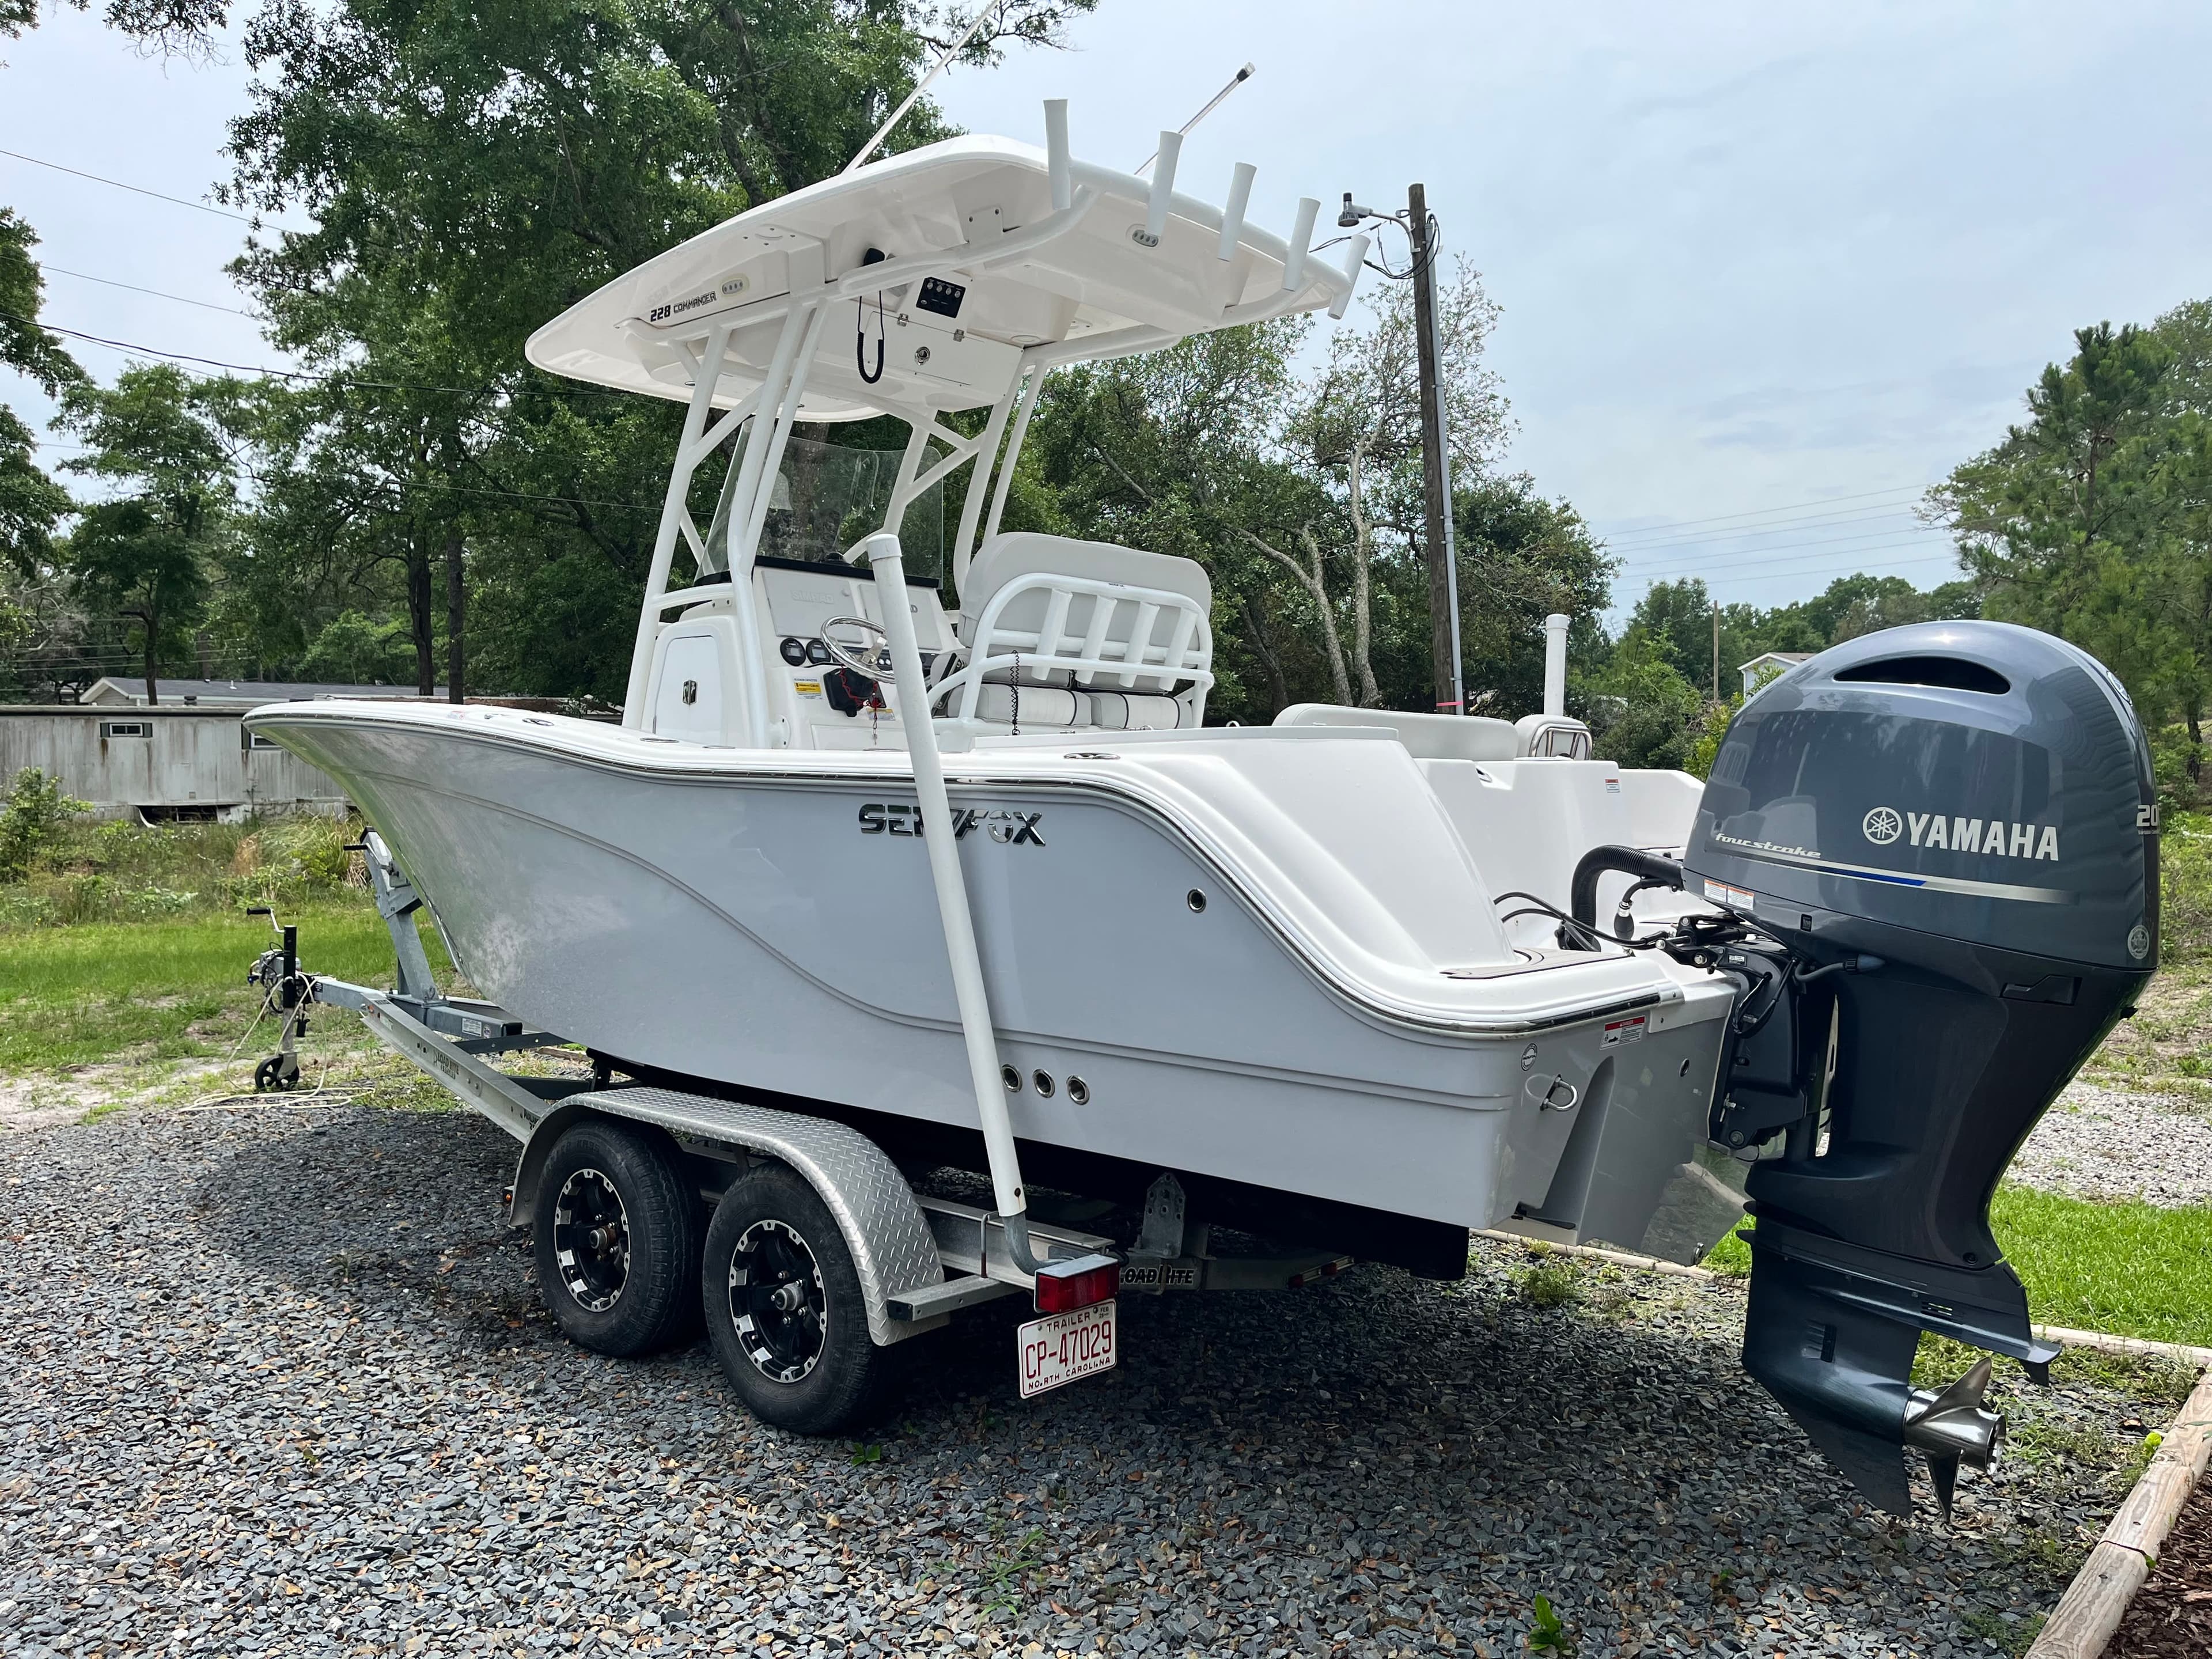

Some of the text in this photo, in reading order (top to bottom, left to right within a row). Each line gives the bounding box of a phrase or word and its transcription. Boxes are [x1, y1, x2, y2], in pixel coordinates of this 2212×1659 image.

[650, 290, 717, 322] 228 COMMANDER
[1715, 832, 1821, 859] fourstroke
[1907, 812, 2059, 861] YAMAHA
[1047, 1312, 1090, 1332] TRAILER
[1025, 1320, 1111, 1379] CP-47029
[1066, 1357, 1111, 1377] CAROLINA
